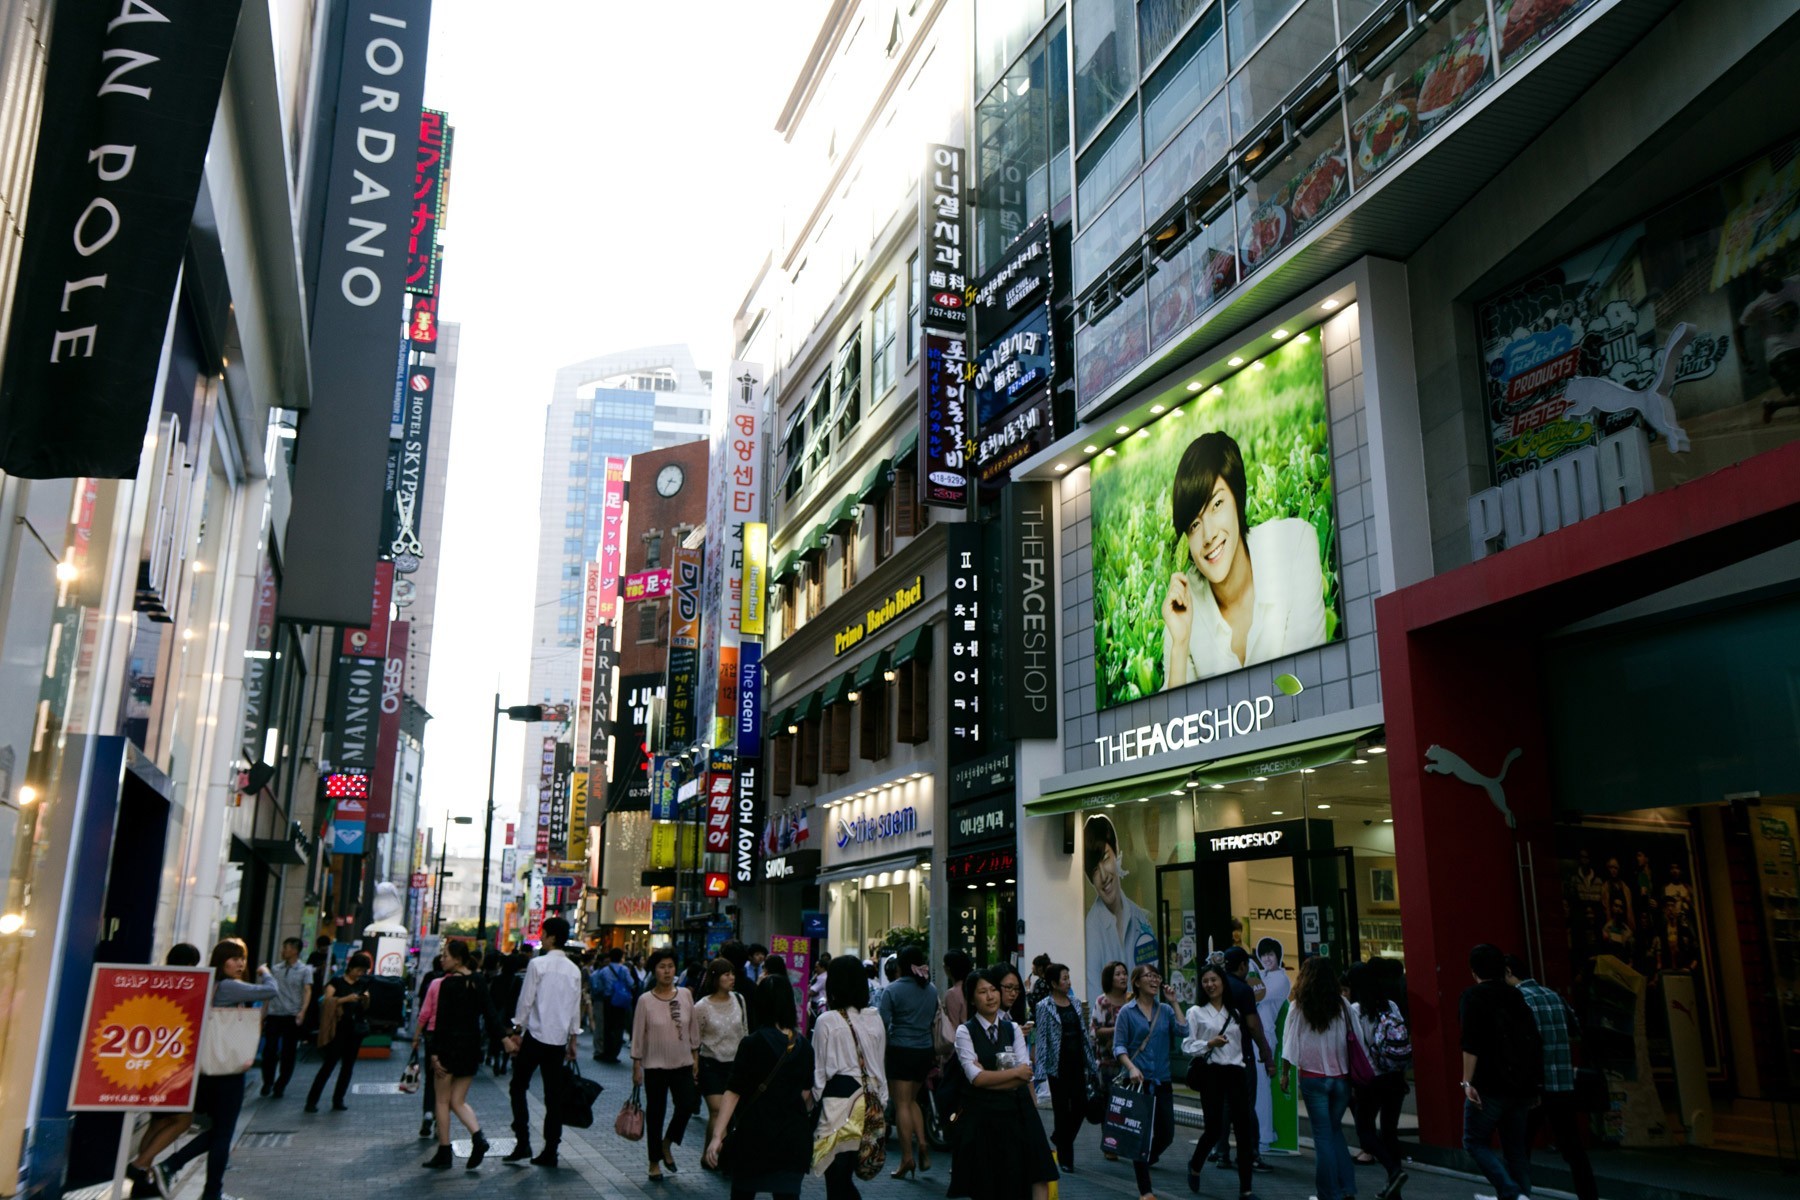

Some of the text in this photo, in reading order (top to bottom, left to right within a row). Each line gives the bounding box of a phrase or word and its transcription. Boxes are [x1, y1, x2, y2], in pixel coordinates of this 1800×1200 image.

[934, 149, 962, 270] 이니셜치과
[49, 144, 137, 366] POLE
[939, 295, 957, 307] 4F
[965, 285, 978, 308] 5F
[929, 306, 966, 322] 757-8275
[414, 331, 431, 341] 21
[964, 362, 978, 382] 4F
[975, 331, 1041, 390] 이니셜치과
[1513, 353, 1574, 400] PRODUCTS
[1007, 368, 1037, 396] 757-8275
[406, 396, 424, 438] HOTEL
[733, 414, 755, 513] 영양센타
[965, 439, 978, 461] 3F
[607, 470, 623, 482] TBC
[931, 473, 965, 486] 318-9292
[1467, 426, 1652, 562] PUMA
[602, 491, 621, 590] 足マッサージ
[625, 585, 645, 598] TBC
[676, 560, 700, 623] DVD
[585, 595, 597, 623] Club
[1021, 504, 1047, 713] THEFACESHOP
[834, 624, 864, 657] Primo
[381, 656, 404, 715] SPAO
[593, 637, 611, 741] TRIANA
[742, 663, 757, 733] the saem
[341, 669, 373, 762] MANGO
[1095, 695, 1274, 767] THEFACESHOP
[711, 761, 733, 771] OPEN
[1245, 757, 1302, 776] THEFACESHOP
[572, 778, 589, 846] NOLITA
[709, 777, 732, 848] 롯데리아
[737, 767, 755, 883] SAVOY HOTEL
[878, 805, 918, 839] saem
[960, 814, 985, 836] 이니셜
[1209, 831, 1284, 852] THEFACESHOP
[765, 857, 786, 879] SAVOY
[150, 975, 195, 990] DAYS
[99, 1023, 185, 1058] 20%
[125, 1058, 153, 1071] OFF
[1109, 1103, 1121, 1114] THE
[1111, 1095, 1133, 1108] THIS IS
